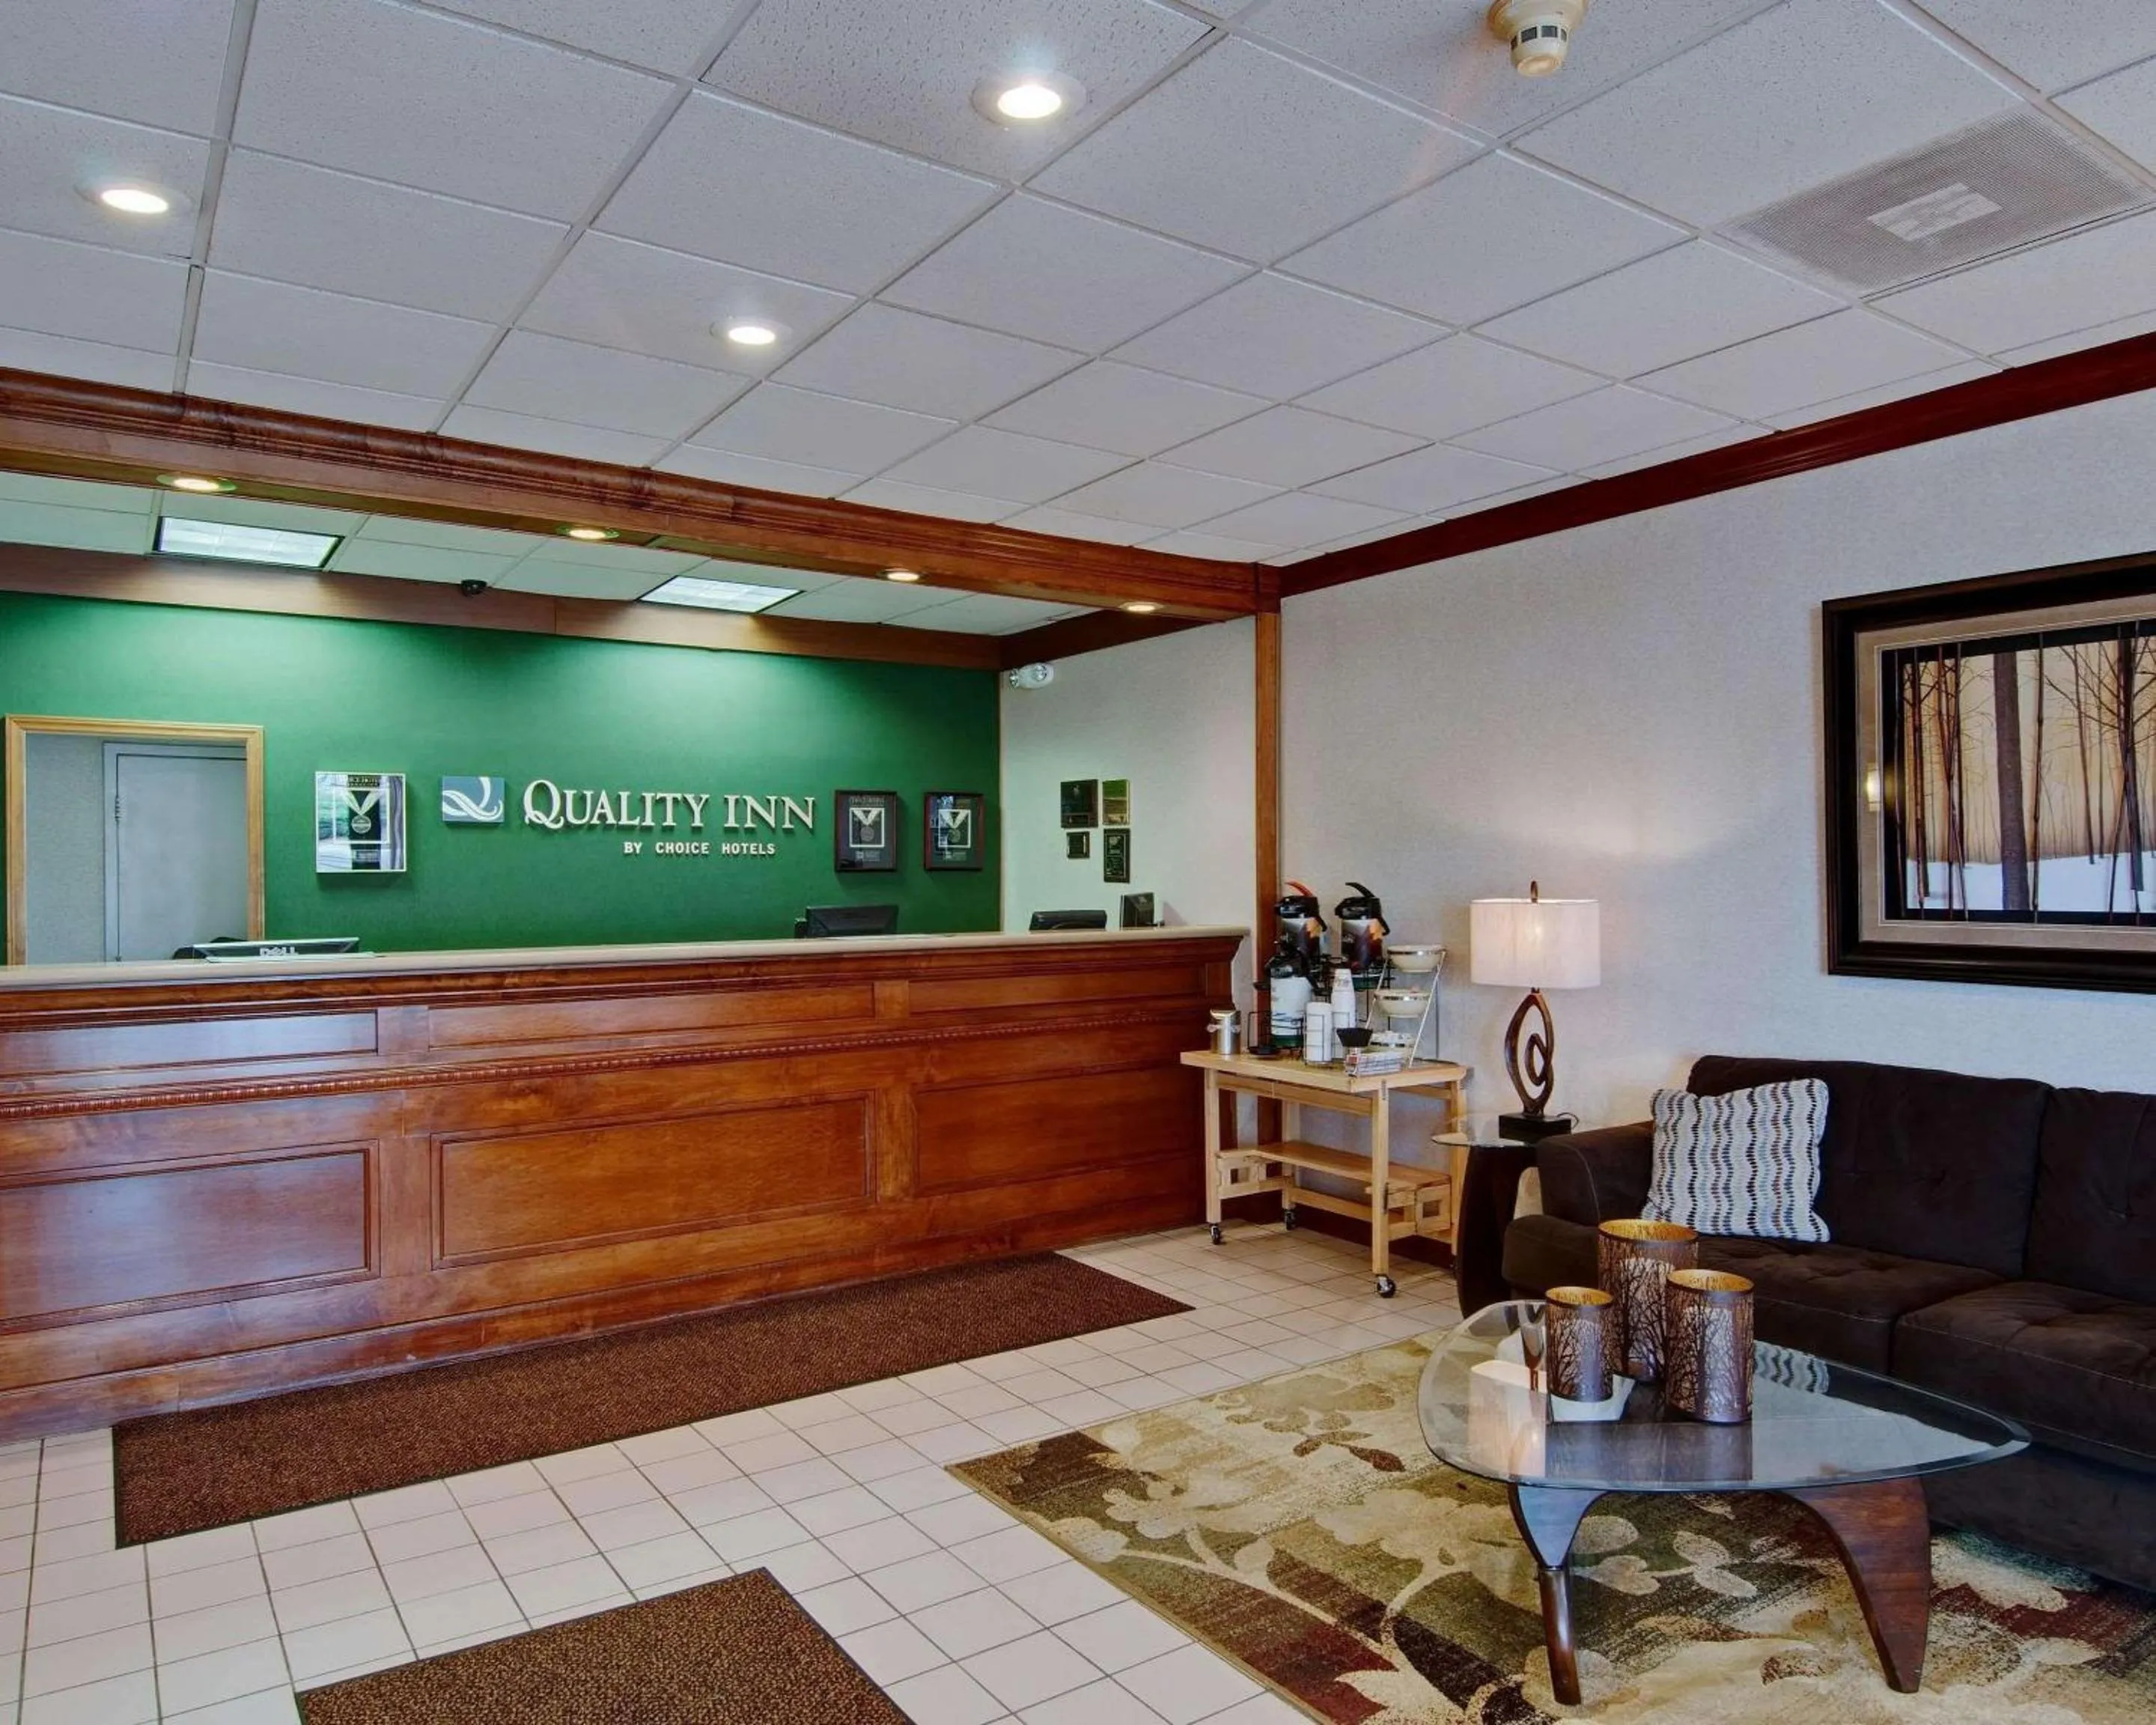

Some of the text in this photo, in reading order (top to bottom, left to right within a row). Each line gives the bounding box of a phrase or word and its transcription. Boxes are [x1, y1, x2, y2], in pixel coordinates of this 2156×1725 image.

[523, 779, 815, 830] QUALITY INN
[623, 842, 776, 855] BY CHOICE HOTELS
